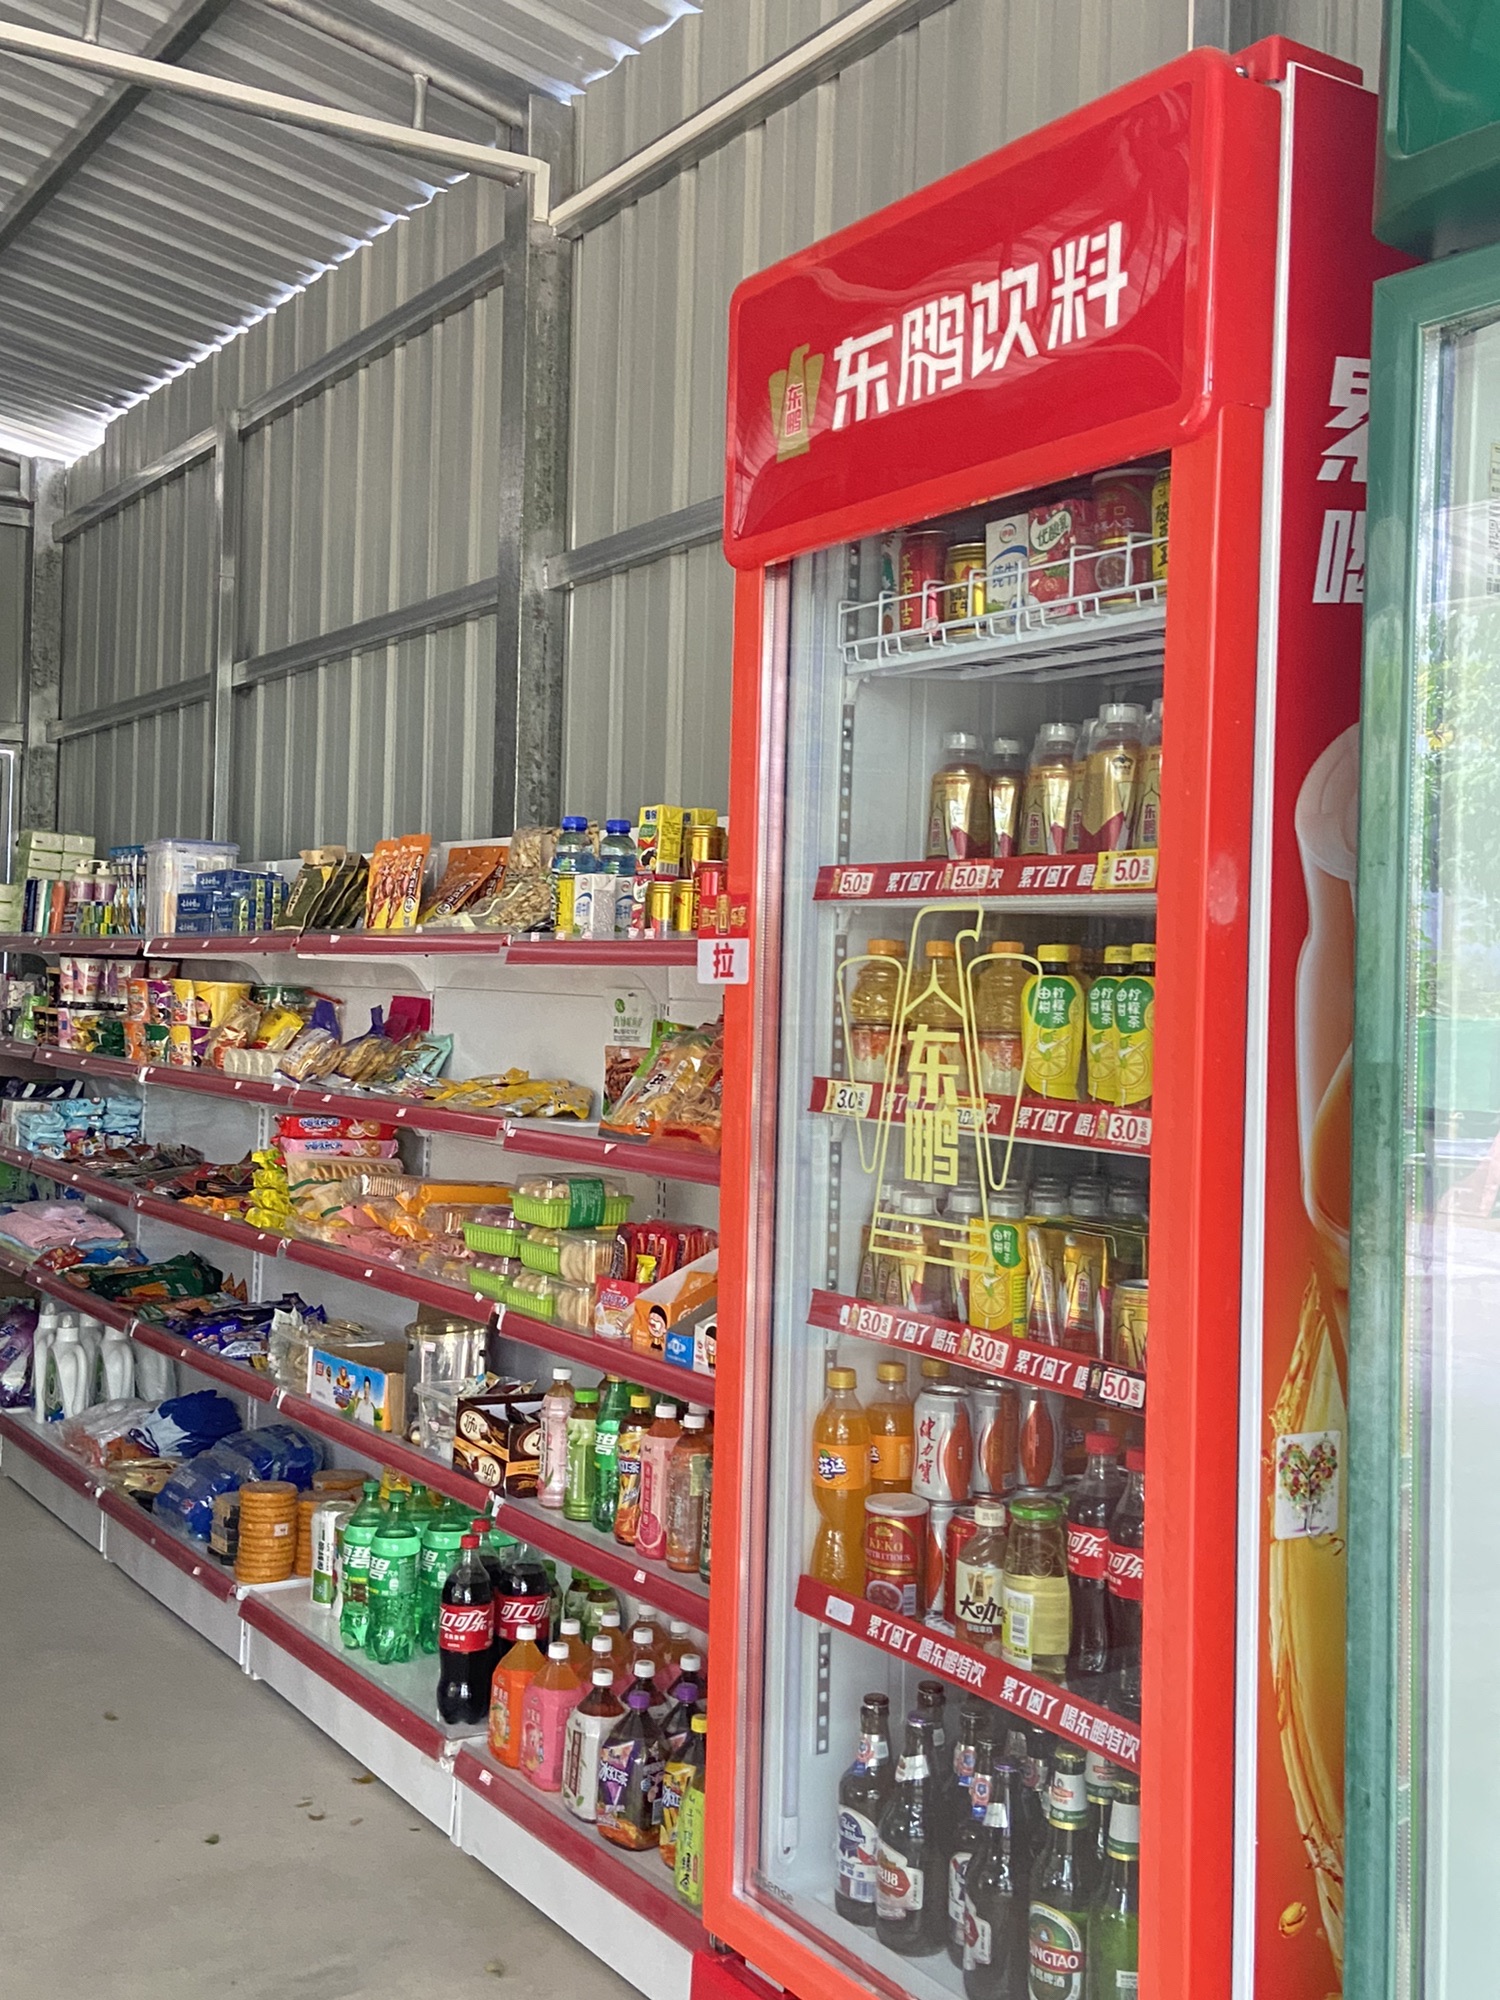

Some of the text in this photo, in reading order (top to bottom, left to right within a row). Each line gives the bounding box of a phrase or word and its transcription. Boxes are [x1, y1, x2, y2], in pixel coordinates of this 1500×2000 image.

[832, 221, 1128, 431] 东鹏饮料
[785, 382, 804, 437] 东鹏
[1037, 516, 1069, 548] 优酸乳
[886, 871, 936, 893] 累了困了
[954, 868, 977, 887] 5.0
[1018, 864, 1077, 889] 累了困了
[1115, 858, 1141, 882] 5.0
[842, 874, 862, 893] 5.0
[713, 942, 734, 979] 拉
[905, 1024, 960, 1185] 东鹏
[1016, 1106, 1073, 1134] 累了困了
[1111, 1116, 1138, 1141] 3.0
[860, 1310, 881, 1334] 3.0
[972, 1337, 996, 1362] 3.0
[1013, 1349, 1073, 1384] 累了困了
[1103, 1374, 1131, 1401] 5.0
[818, 1455, 848, 1475] 芬达
[869, 1537, 904, 1553] KEKO
[867, 1614, 987, 1688] 累了困了 喝东鹏特饮
[1000, 1675, 1140, 1763] 累了困了 喝东鹏特饮
